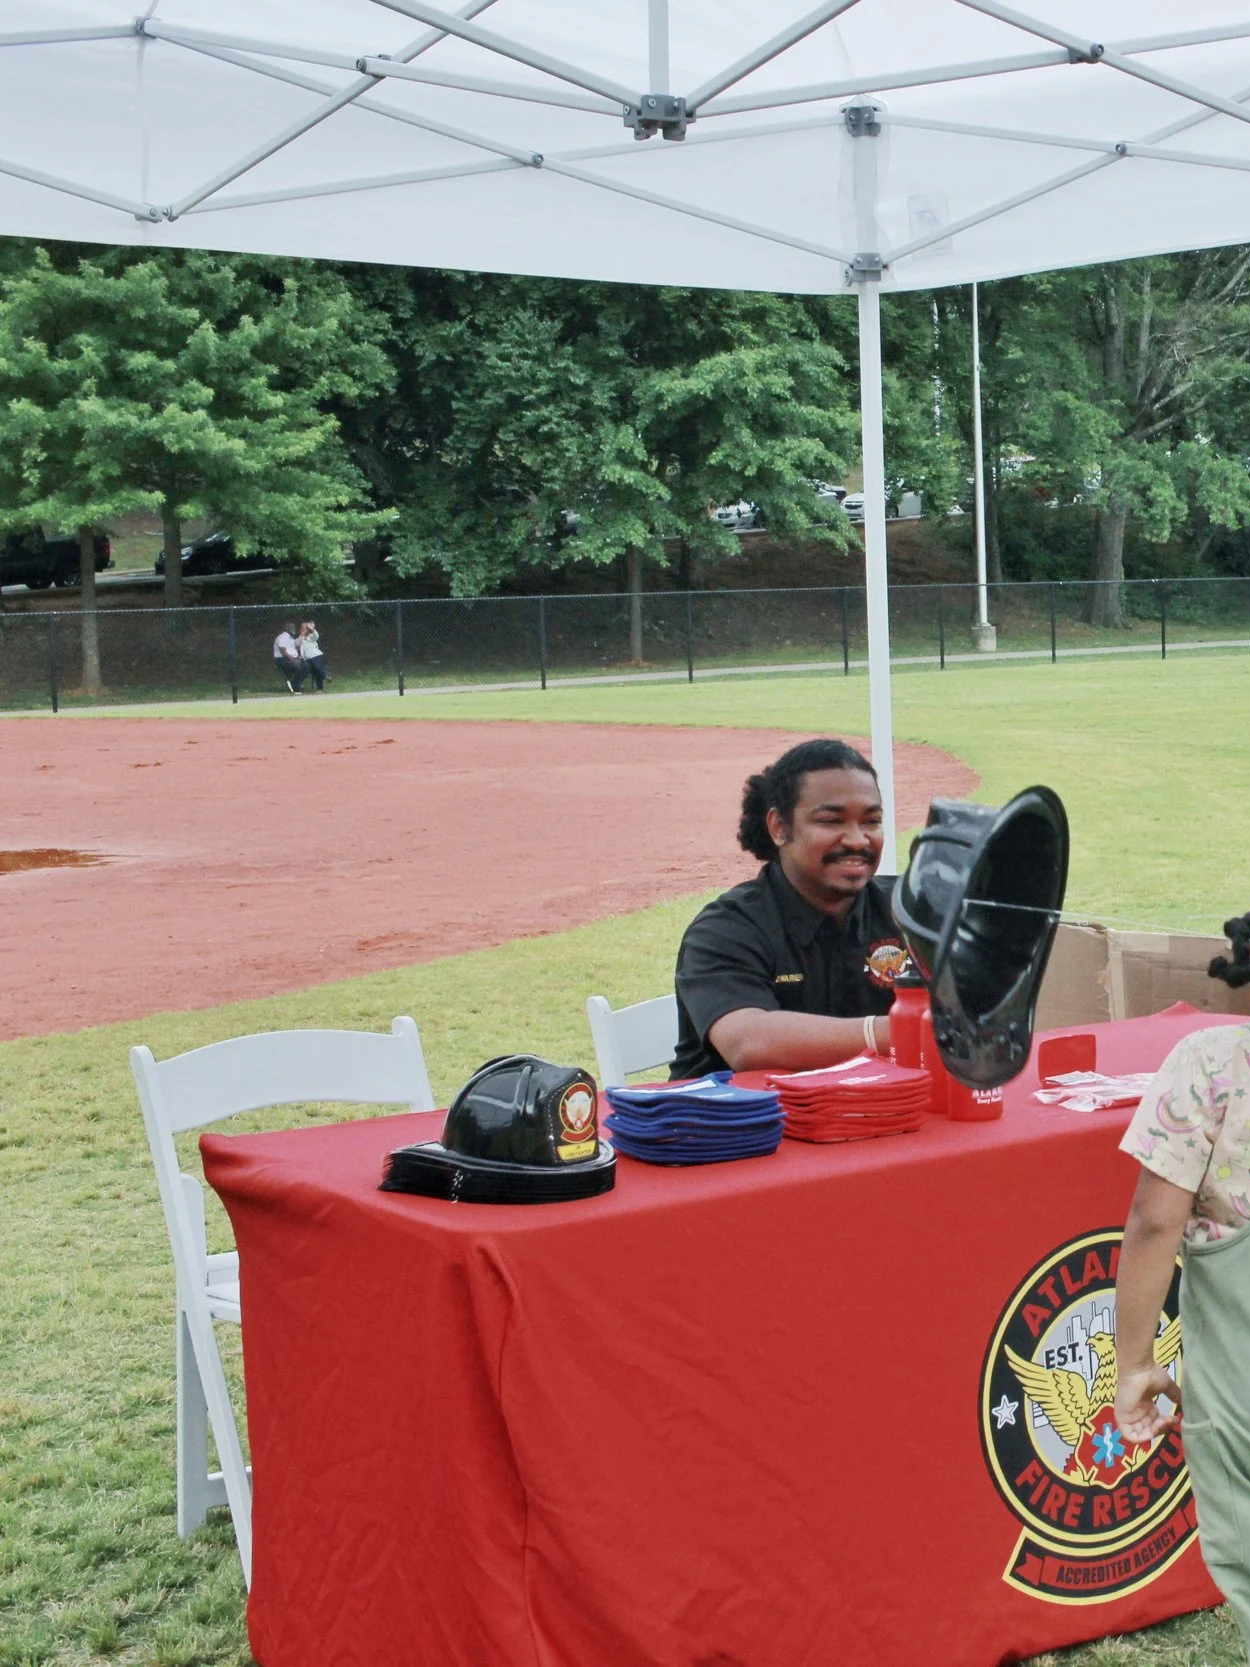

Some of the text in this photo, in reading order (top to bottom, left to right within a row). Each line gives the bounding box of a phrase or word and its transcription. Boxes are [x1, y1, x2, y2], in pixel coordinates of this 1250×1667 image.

[1021, 1245, 1121, 1339] ATLA
[1044, 1341, 1084, 1370] EST.
[1014, 1411, 1185, 1528] FIRE RESCU
[1055, 1524, 1177, 1585] ACCREDITED AGENCY
